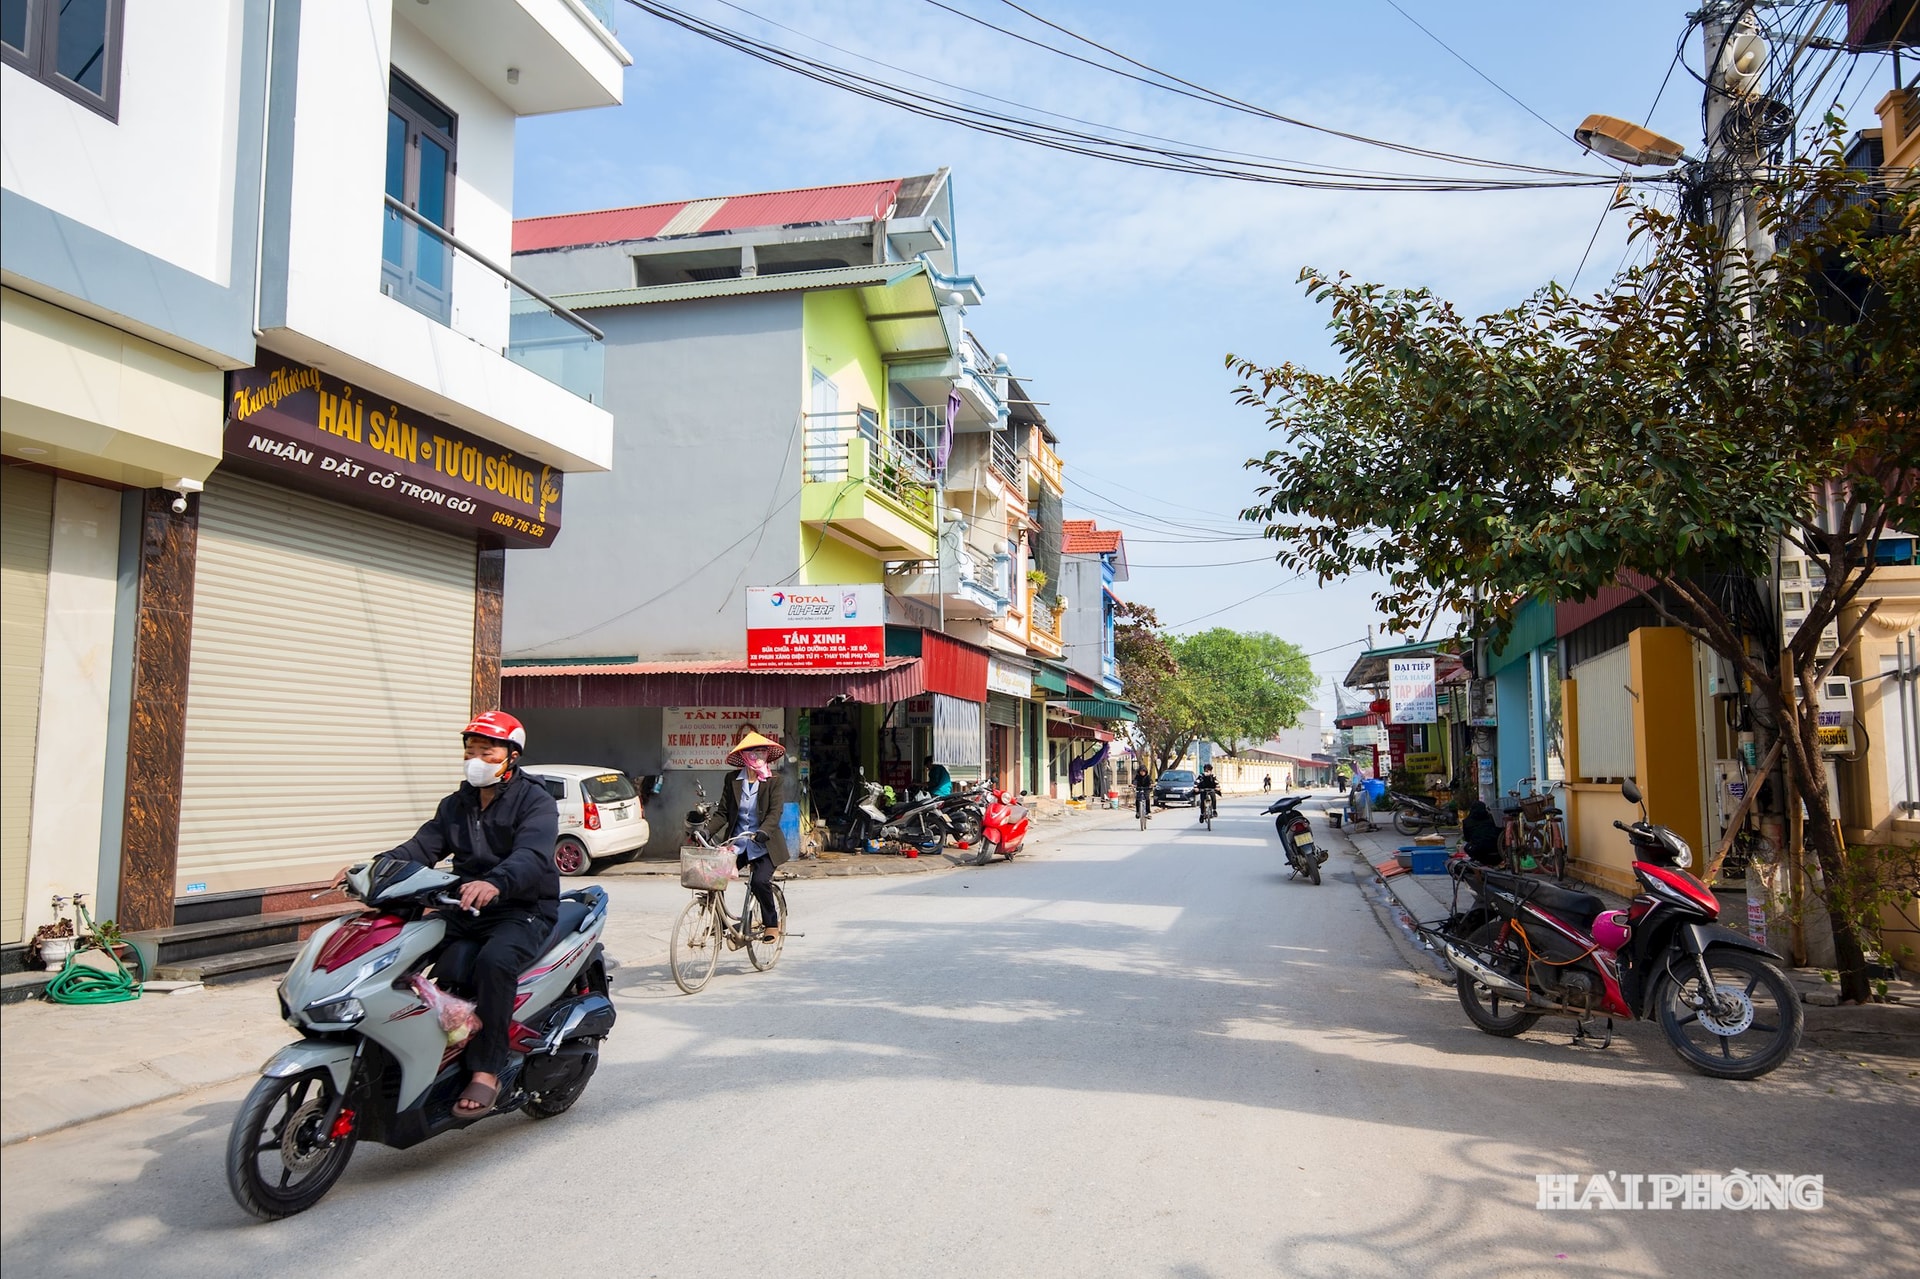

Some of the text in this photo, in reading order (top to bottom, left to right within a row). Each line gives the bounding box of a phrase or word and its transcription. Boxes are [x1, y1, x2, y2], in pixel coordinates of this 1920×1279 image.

[369, 405, 418, 464] SẢN
[433, 435, 483, 486] TƯƠI
[485, 453, 535, 505] SỐNG
[247, 435, 477, 515] NHẬN ĐẶT CỖ TRỌN GÓI
[491, 511, 546, 538] 0936 716 325
[788, 594, 828, 603] TOTAL
[812, 634, 846, 644] XINH
[1394, 664, 1410, 672] ĐẠI
[1394, 682, 1433, 701] TẠP HÓA
[721, 711, 761, 720] XINH
[668, 734, 677, 746] XE
[700, 734, 710, 746] XE
